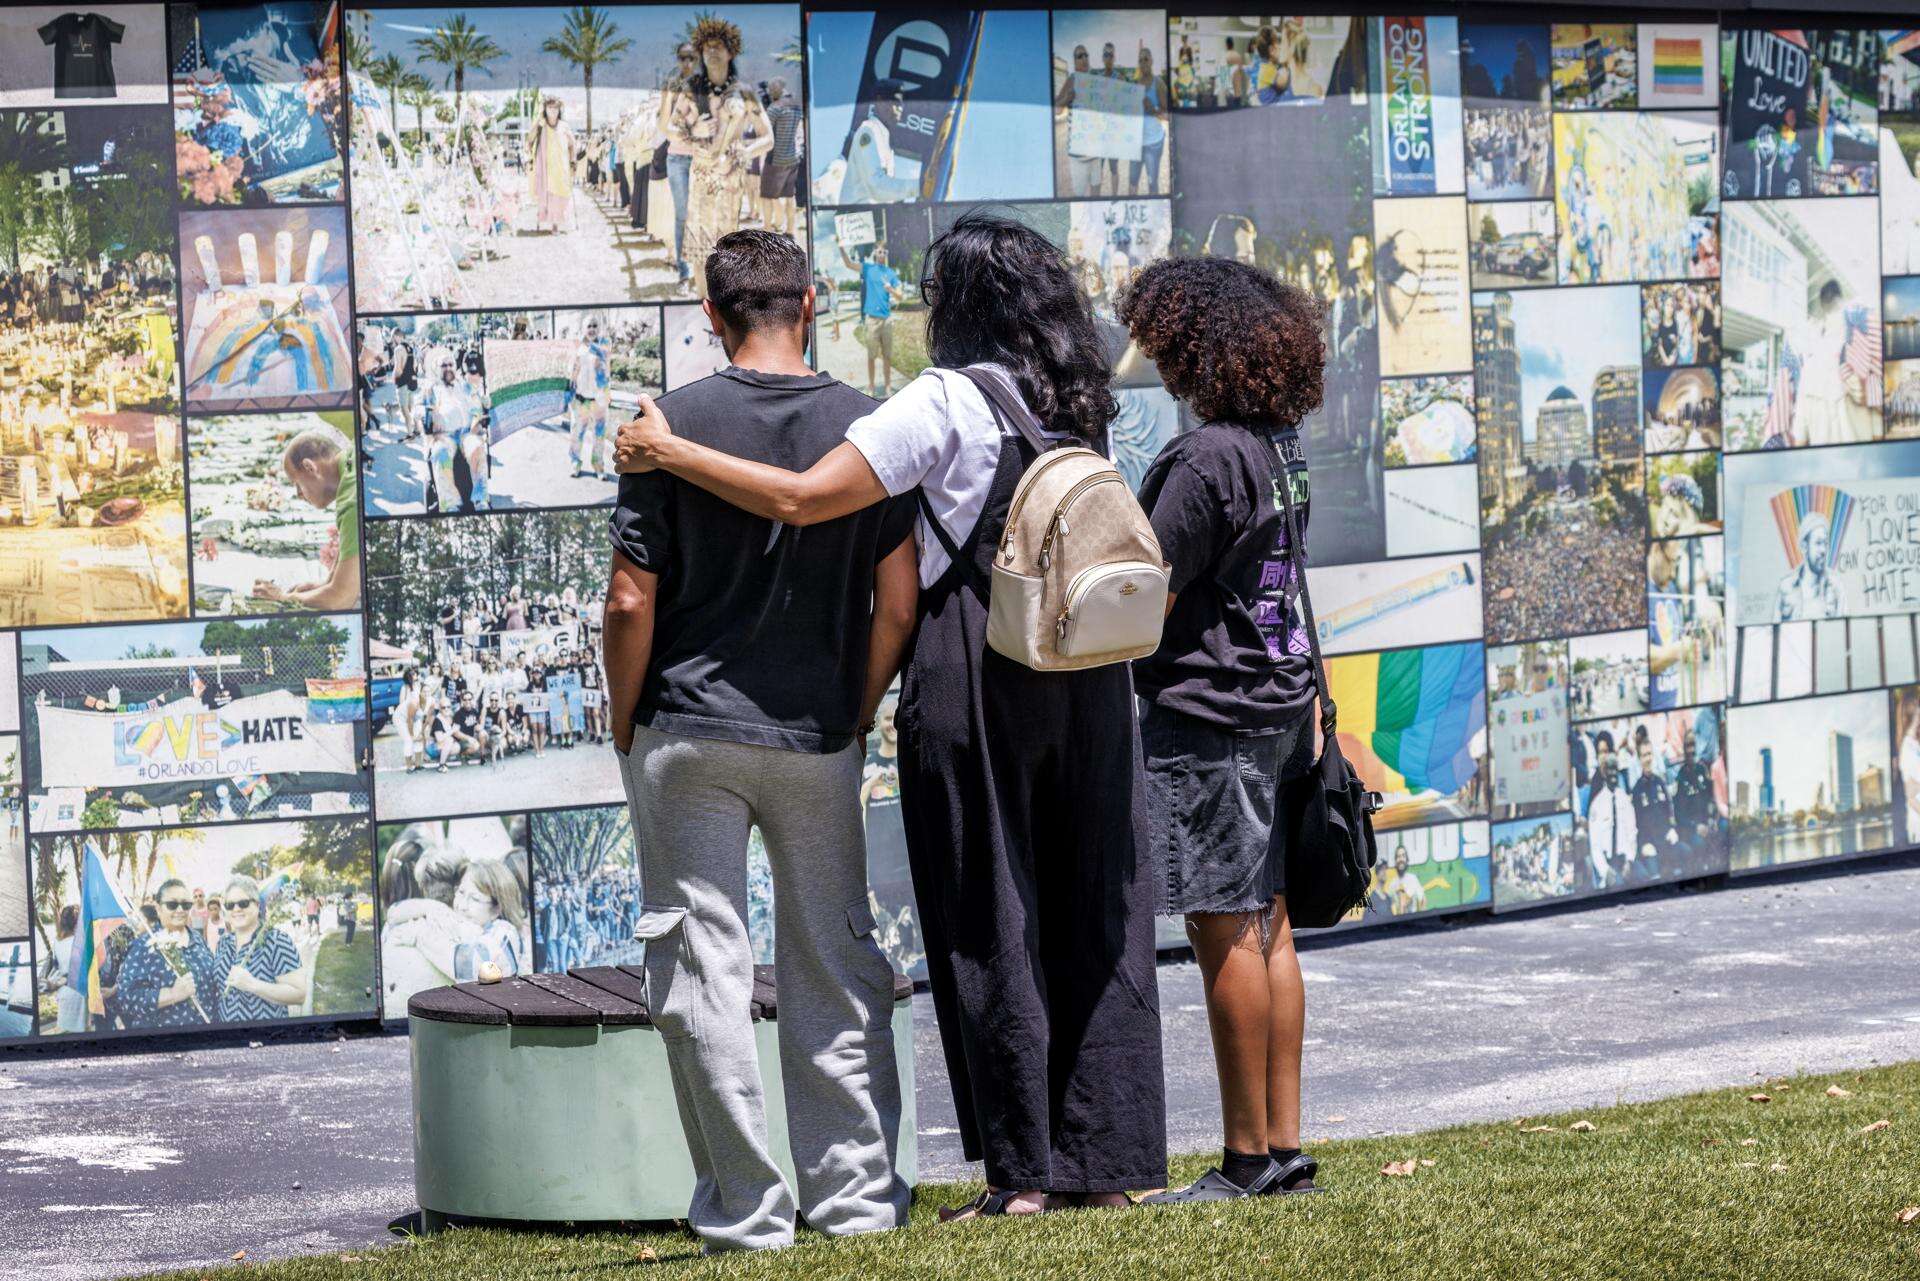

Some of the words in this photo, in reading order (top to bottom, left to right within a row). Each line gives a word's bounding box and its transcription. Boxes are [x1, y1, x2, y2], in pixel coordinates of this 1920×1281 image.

[1743, 30, 1807, 88] UNITED
[1389, 23, 1410, 161] ORLANDO
[1406, 28, 1430, 160] STRONG
[1748, 76, 1786, 112] Love
[1867, 514, 1920, 545] LOVE
[1838, 548, 1860, 573] CAN
[242, 716, 303, 745] HATE
